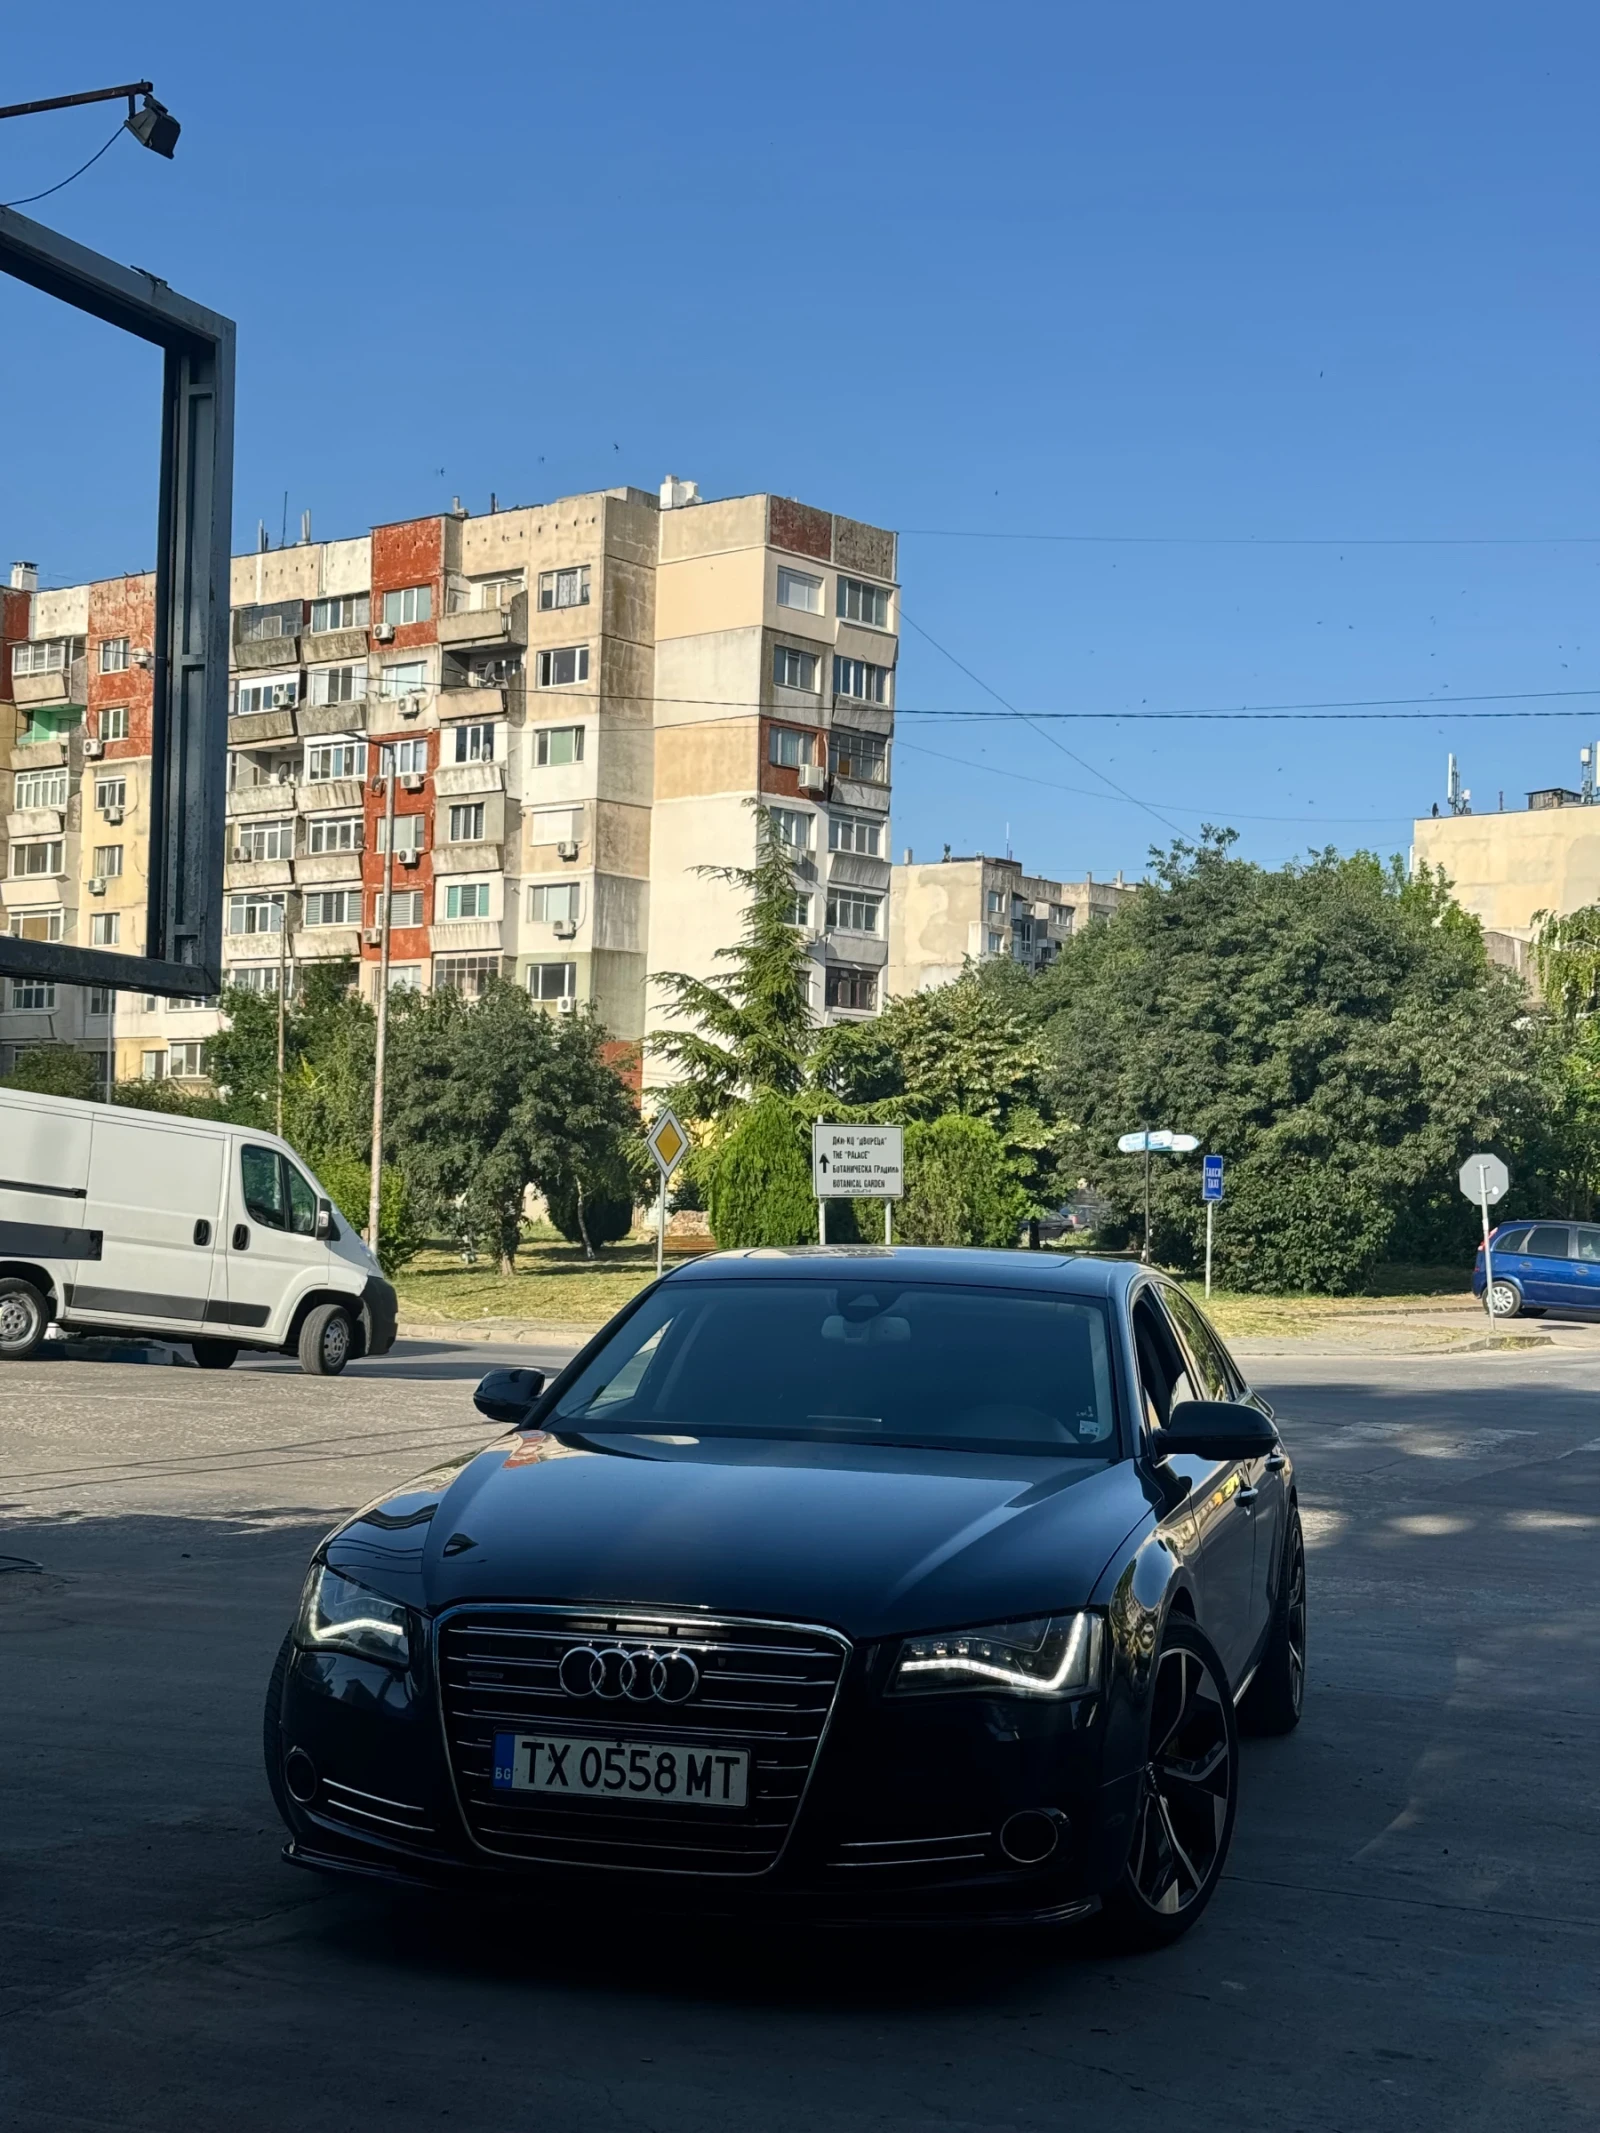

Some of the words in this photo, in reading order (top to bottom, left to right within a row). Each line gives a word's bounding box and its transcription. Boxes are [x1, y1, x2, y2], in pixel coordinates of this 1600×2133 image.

[833, 1150, 843, 1159] THE
[833, 1180, 862, 1188] BOTANICAL
[864, 1180, 885, 1188] GARDEN
[1208, 1179, 1219, 1188] TAXI
[521, 1741, 572, 1787] TX
[580, 1746, 677, 1794] 0558
[686, 1753, 741, 1799] MT
